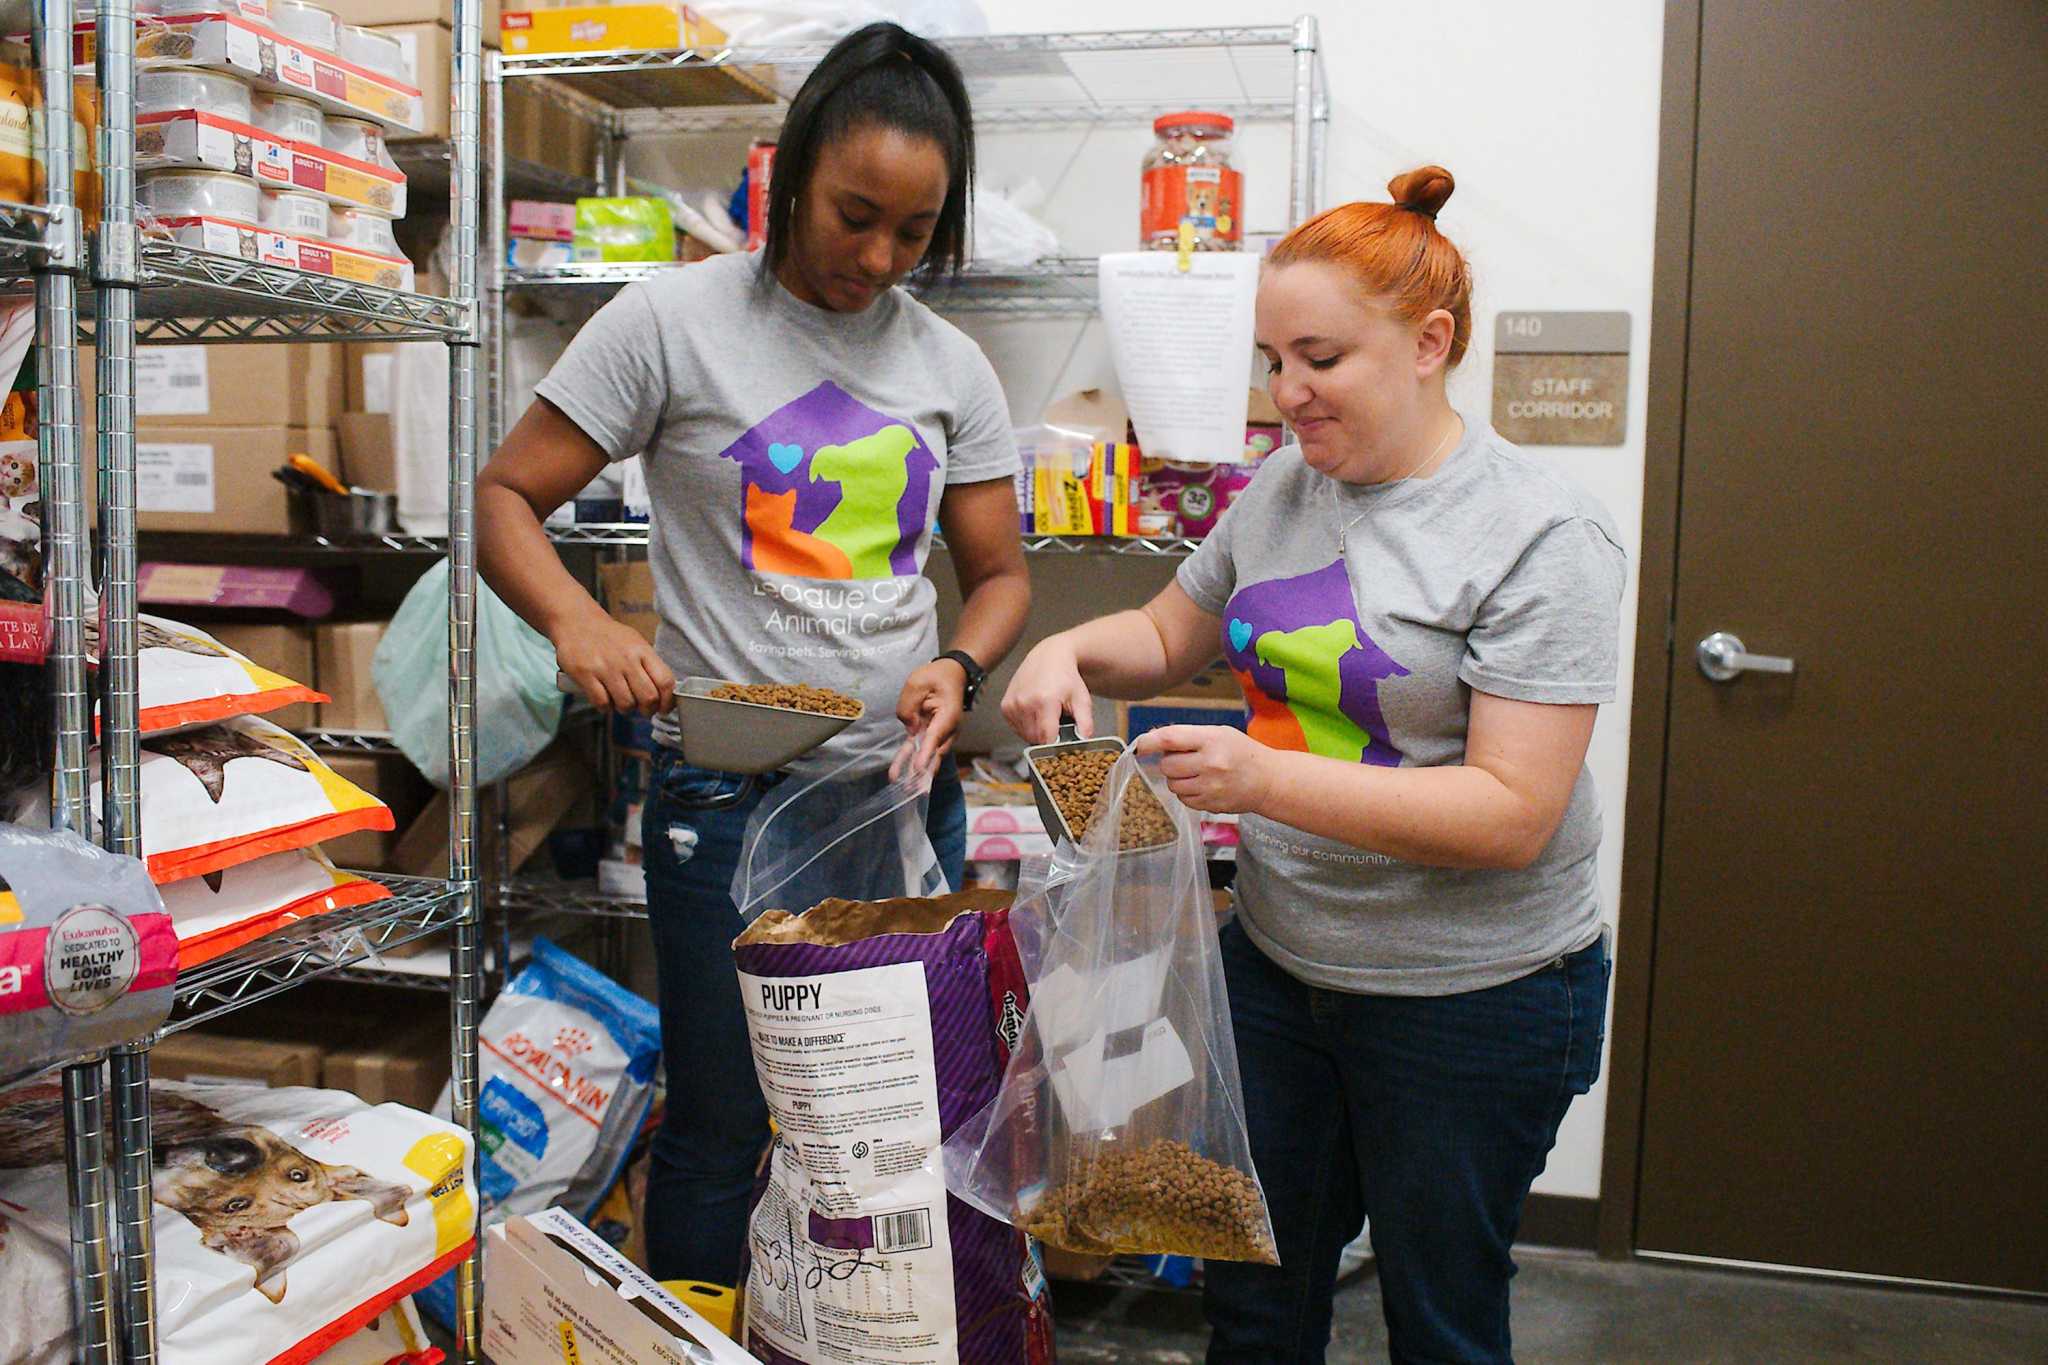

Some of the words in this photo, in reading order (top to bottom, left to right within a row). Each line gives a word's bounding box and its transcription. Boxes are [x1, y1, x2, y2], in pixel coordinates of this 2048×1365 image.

[1504, 317, 1542, 336] 140
[1531, 378, 1593, 395] STAFF
[1507, 401, 1613, 418] CORRIDOR
[872, 578, 913, 603] Cit
[22, 621, 39, 635] DE
[765, 608, 852, 635] Animal
[8, 633, 30, 649] LA
[1291, 844, 1310, 857] our
[62, 926, 120, 942] Eukanuba
[64, 940, 109, 952] DEDICATED
[109, 937, 121, 949] TO
[60, 950, 125, 969] HEALTHY
[73, 964, 112, 981] LONG
[761, 983, 822, 1011] PUPPY
[1003, 992, 1020, 1049] Diamo
[778, 1035, 796, 1047] MAKE
[792, 1100, 811, 1111] PUPPY
[432, 1184, 449, 1199] FOR
[629, 1274, 668, 1300] GALLON
